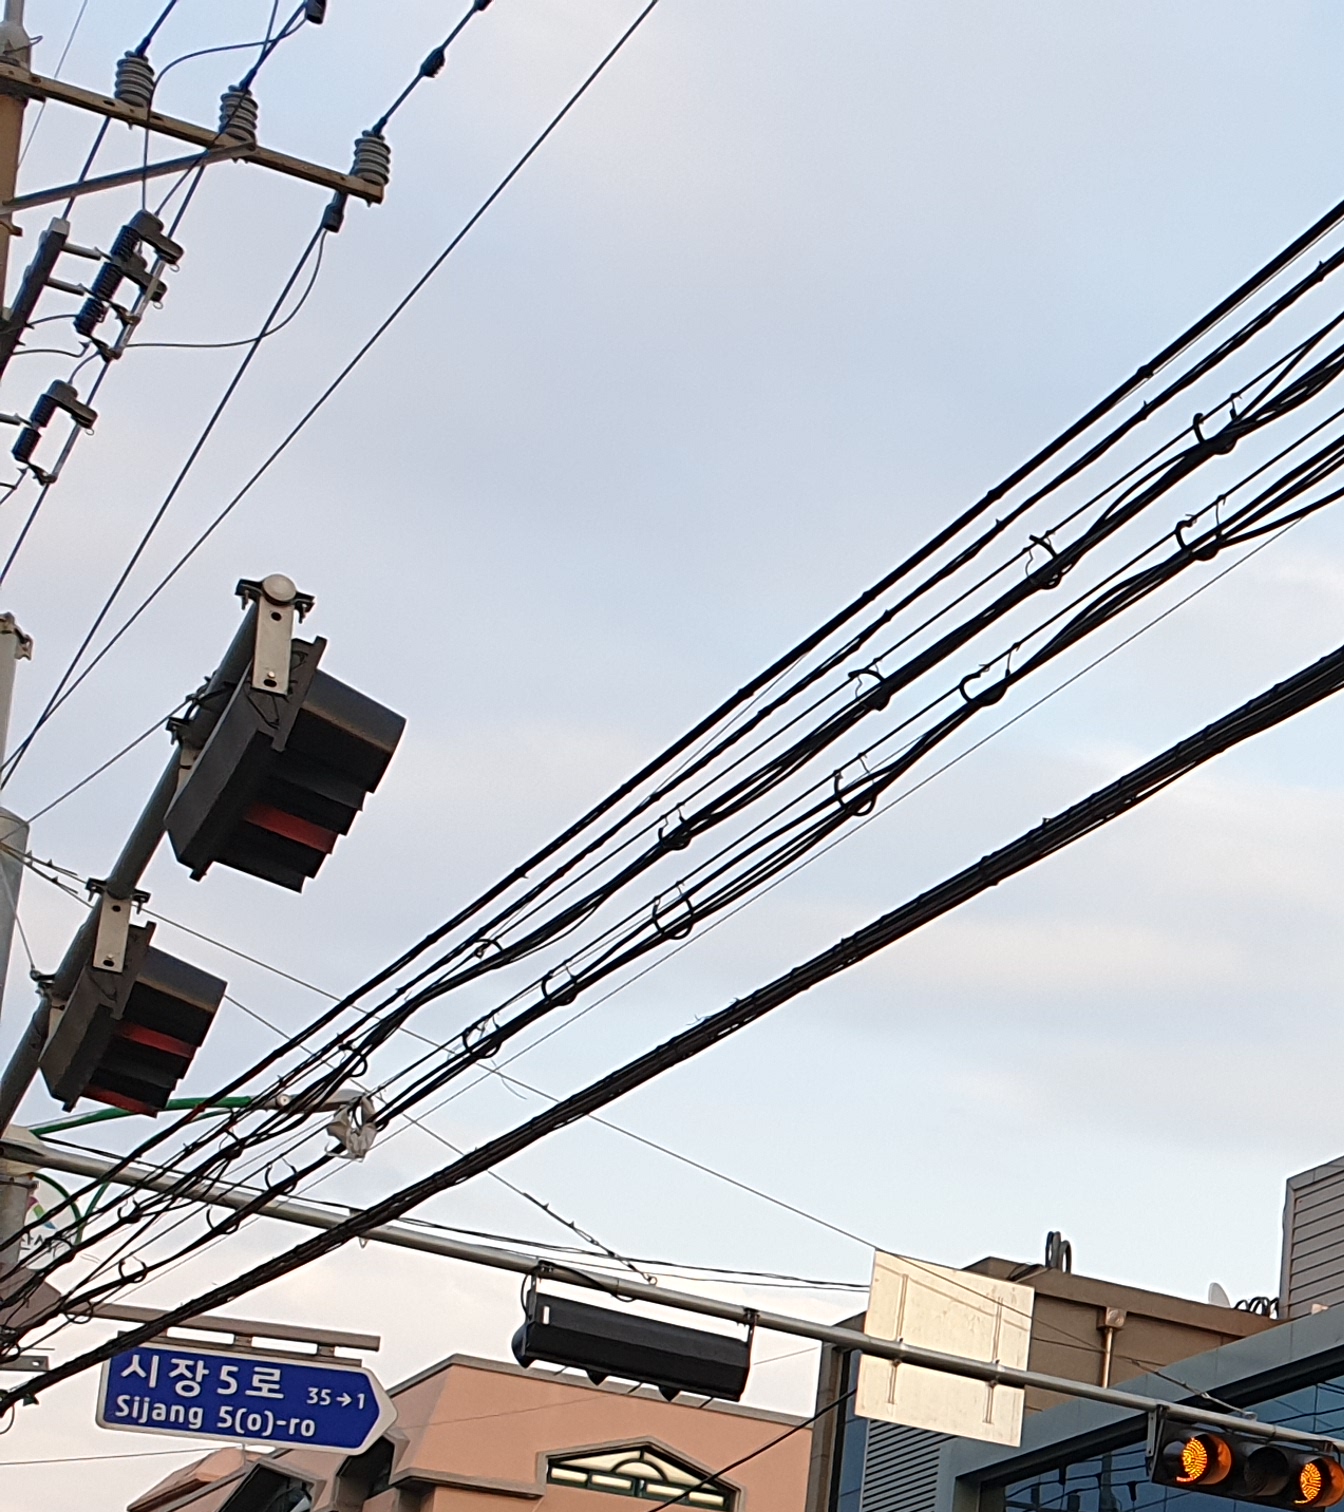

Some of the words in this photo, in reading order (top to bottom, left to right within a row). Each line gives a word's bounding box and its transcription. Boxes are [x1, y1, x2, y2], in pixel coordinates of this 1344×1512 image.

[121, 1354, 284, 1400] 시장5로
[306, 1387, 331, 1406] 35
[115, 1395, 204, 1430] Sijang
[217, 1406, 316, 1437] 5(o)-ro
